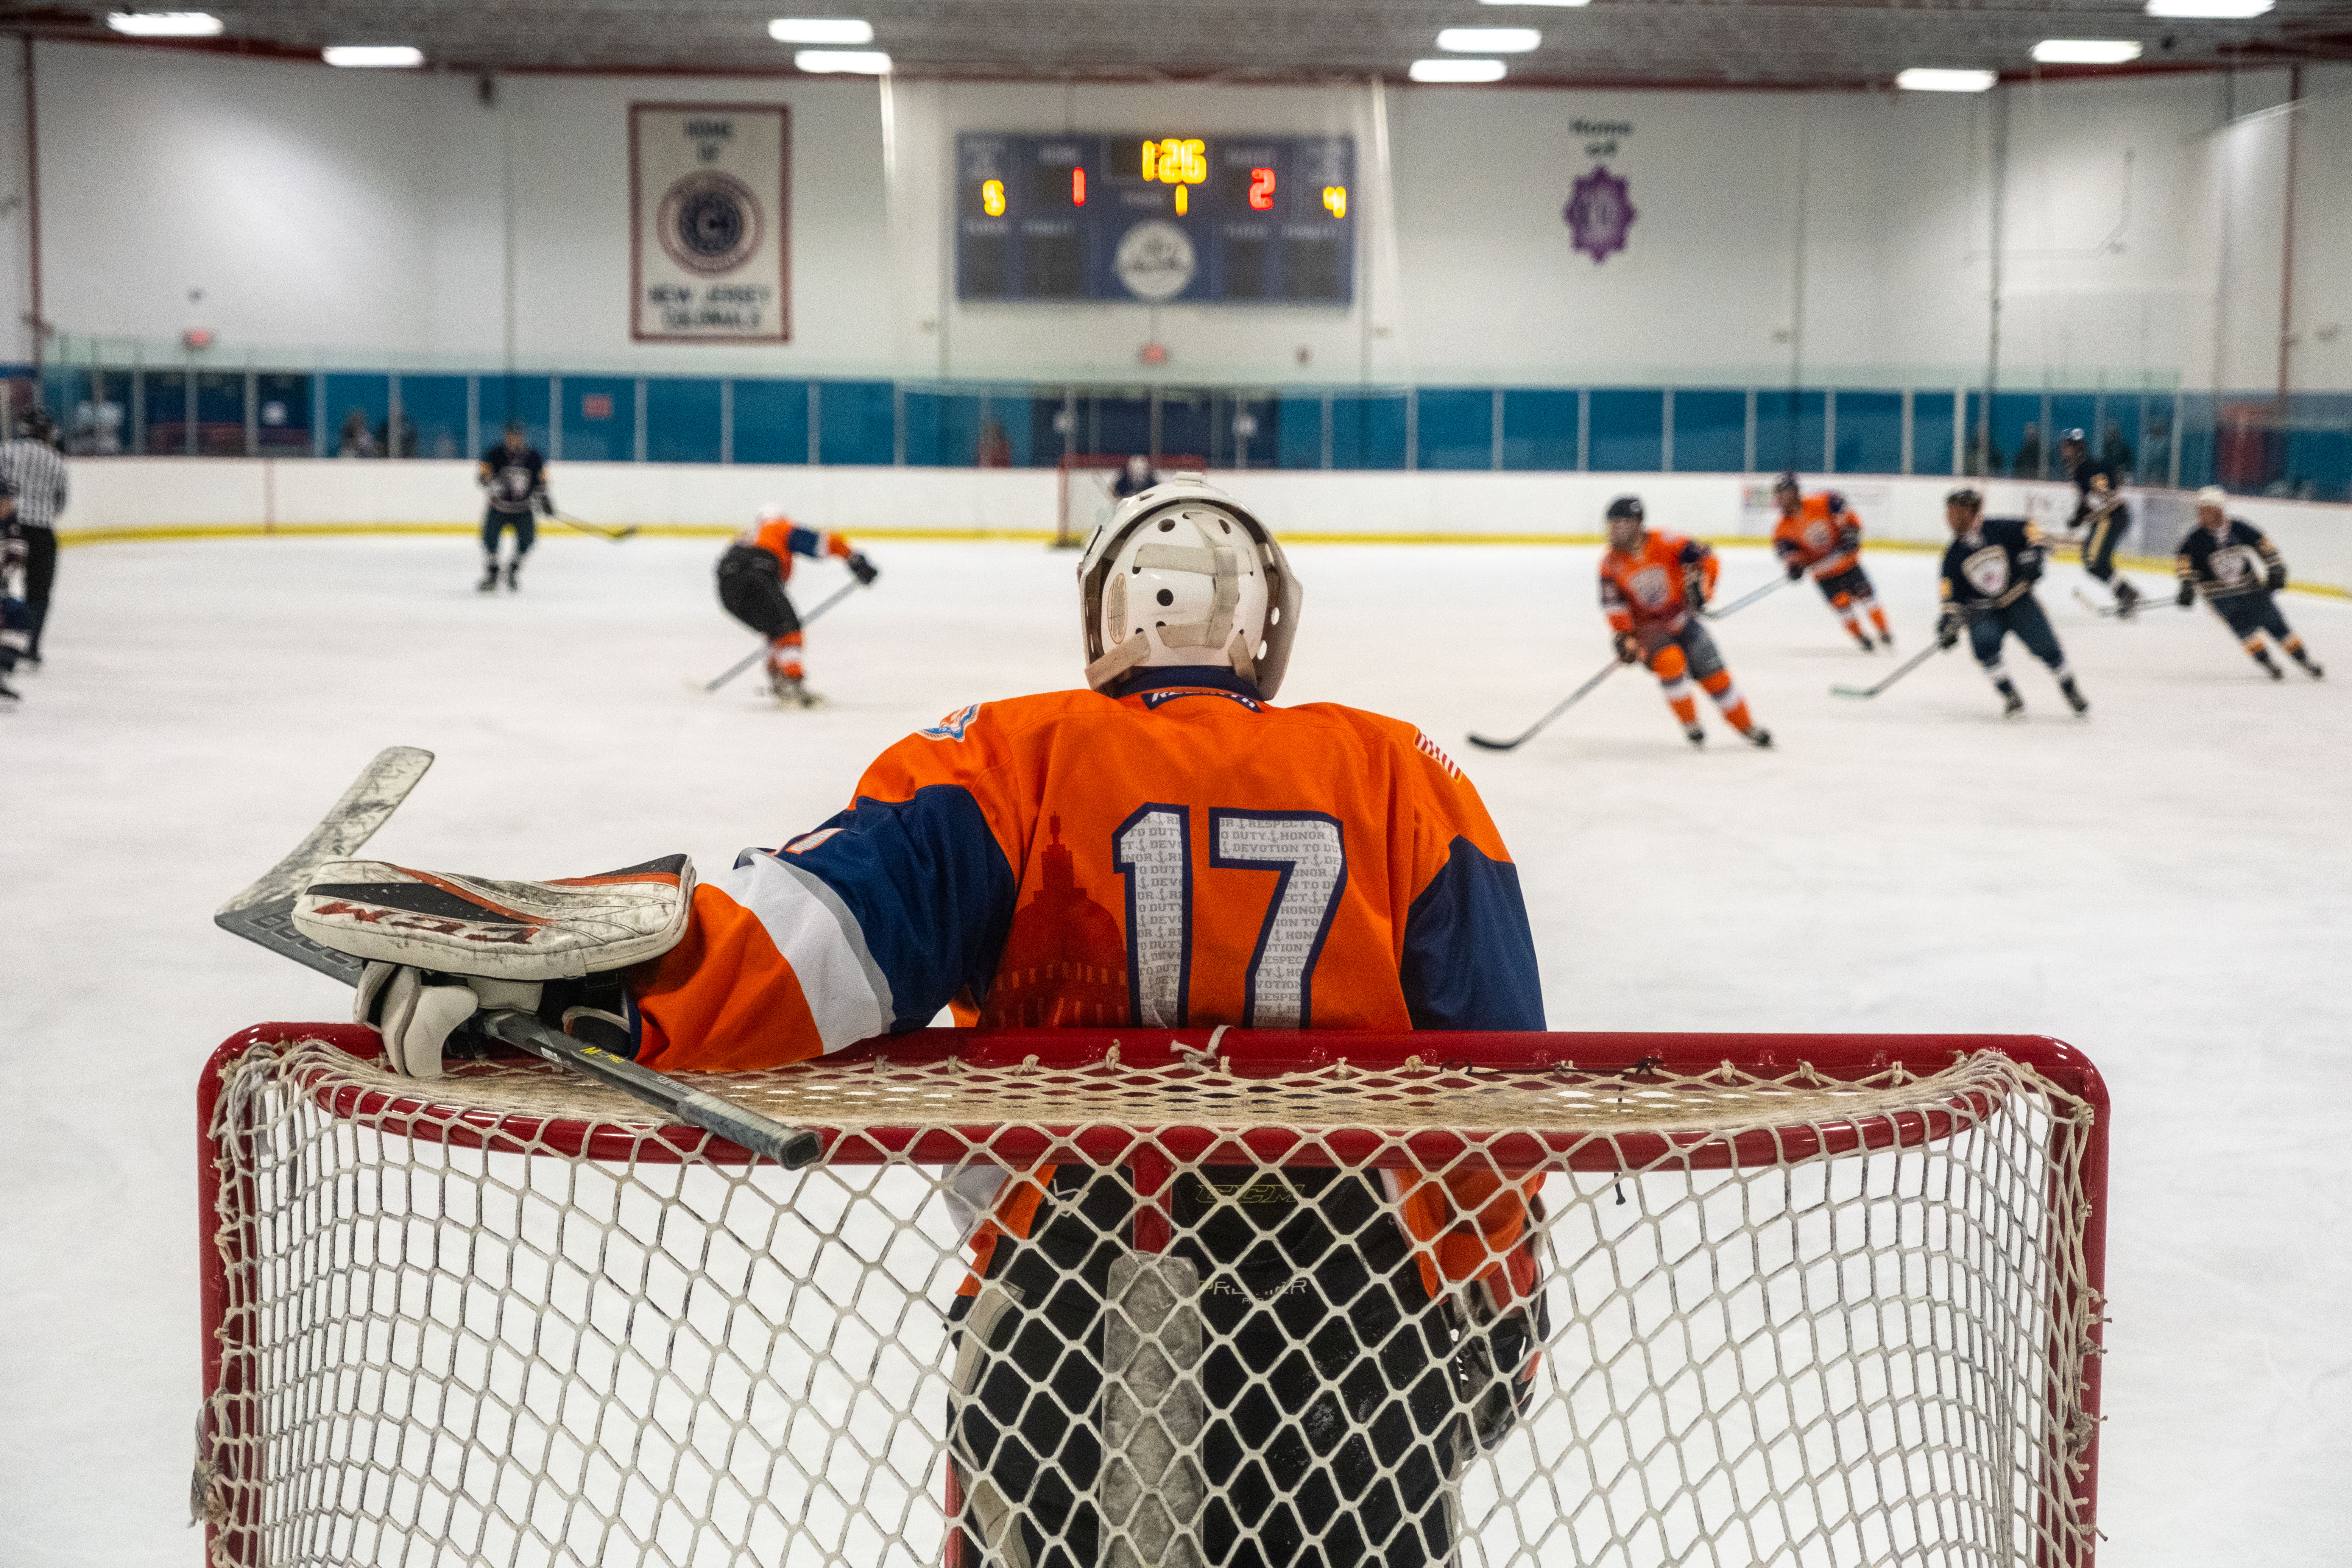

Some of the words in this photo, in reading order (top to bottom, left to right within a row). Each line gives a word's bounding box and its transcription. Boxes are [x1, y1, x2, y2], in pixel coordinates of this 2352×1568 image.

[1072, 167, 1086, 206] 1
[1175, 184, 1188, 216] 1
[1249, 168, 1275, 210] 2
[1323, 186, 1347, 218] 4
[1233, 831, 1266, 840] DUTY
[1280, 831, 1325, 840] HONOR
[1233, 844, 1299, 853] DEVOTION
[1302, 844, 1320, 852] TO
[1111, 802, 1348, 1029] 17
[1196, 1184, 1305, 1203] CCM
